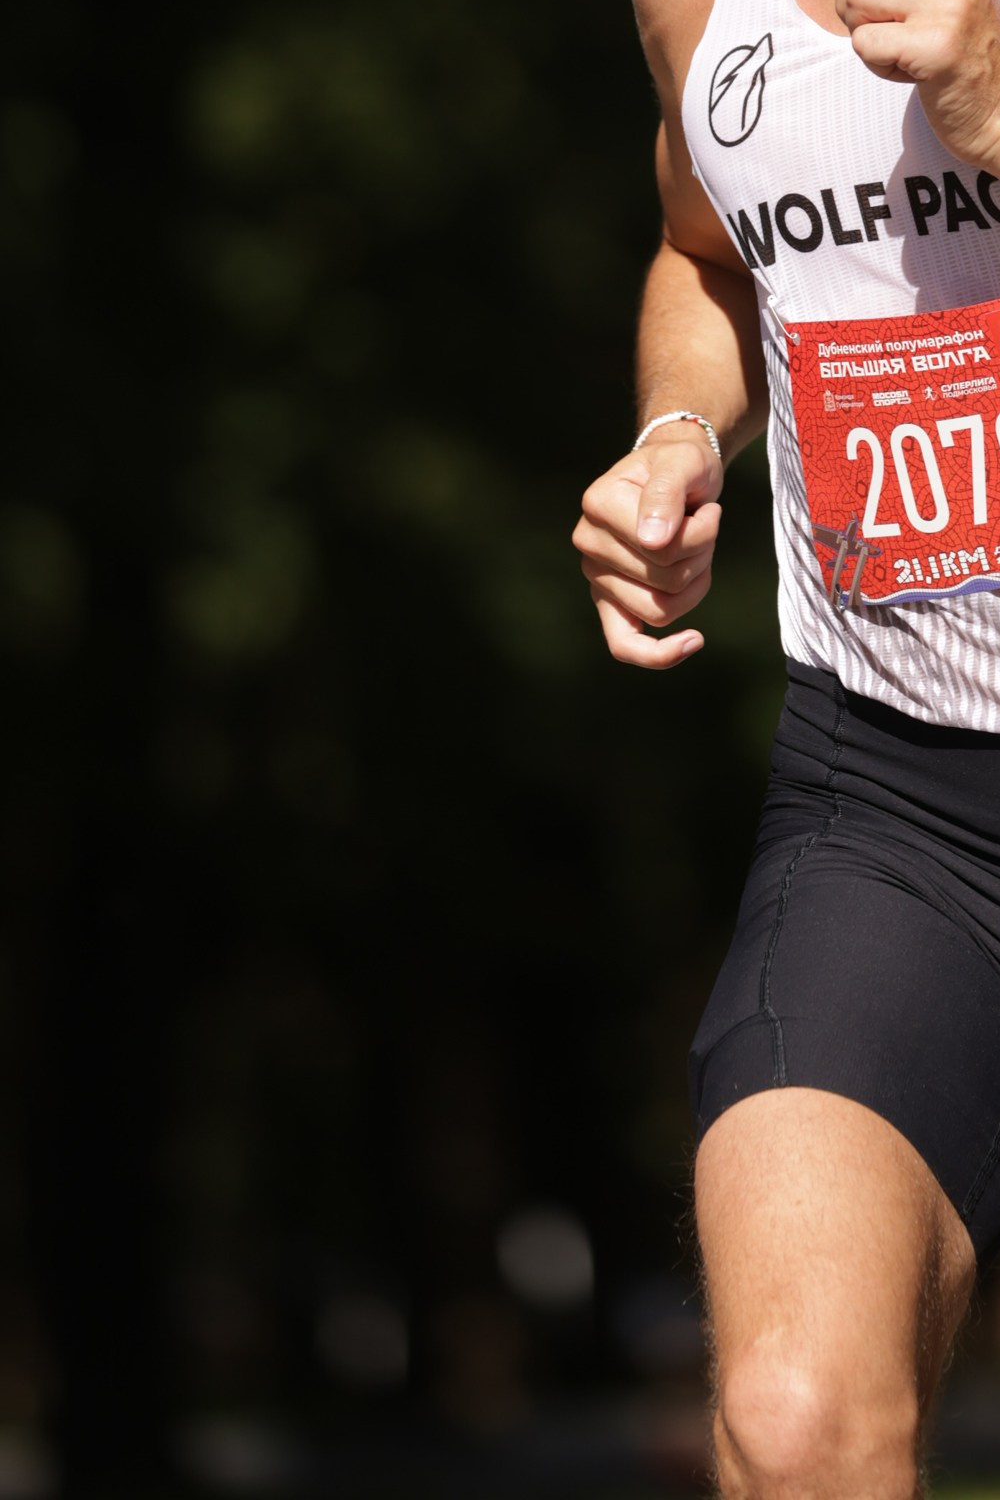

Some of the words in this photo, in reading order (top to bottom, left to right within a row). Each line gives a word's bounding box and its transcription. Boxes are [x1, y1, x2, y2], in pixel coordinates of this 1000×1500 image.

[726, 181, 892, 270] WOLF
[817, 340, 884, 358] Дубненский
[885, 329, 985, 353] полумарафон
[819, 357, 907, 378] БОЛЬШАЯ
[911, 345, 992, 372] ВОЛГА
[941, 376, 996, 393] СУПЕРЛИГА
[942, 384, 998, 399] ПОДМОСКОВЬЯ
